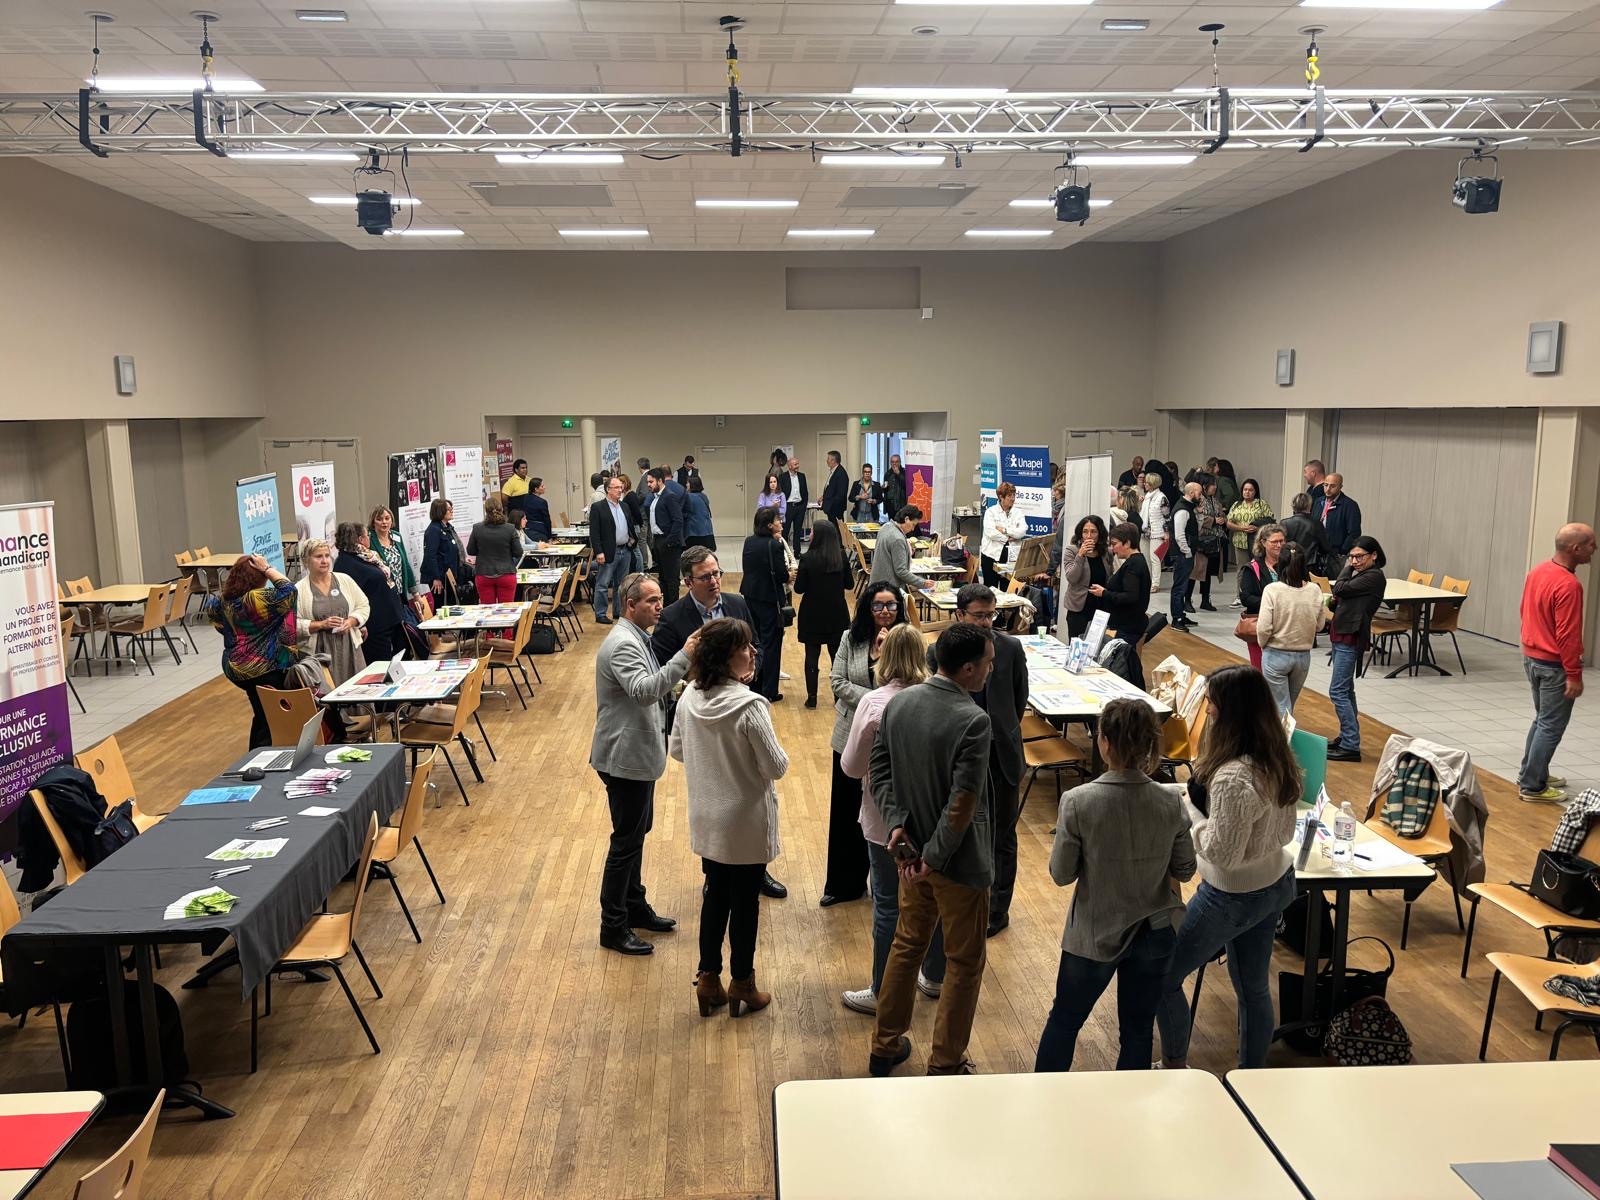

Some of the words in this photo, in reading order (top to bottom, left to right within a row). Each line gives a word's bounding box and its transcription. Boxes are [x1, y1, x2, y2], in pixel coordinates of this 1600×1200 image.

[1018, 458, 1043, 471] Unapei
[0, 550, 50, 567] andicap
[15, 604, 36, 616] VOUS
[37, 600, 55, 611] AVEZ
[5, 620, 17, 631] UN
[18, 614, 45, 628] PROJET
[46, 611, 56, 620] DE
[3, 626, 46, 644] FORMATION
[47, 623, 57, 632] EN
[7, 637, 54, 655] ALTERNANCE
[0, 713, 12, 724] UR
[12, 708, 27, 720] UNE
[28, 752, 40, 763] QUI
[40, 746, 56, 758] AIDE
[22, 767, 31, 776] EN
[32, 753, 64, 772] SITUATION
